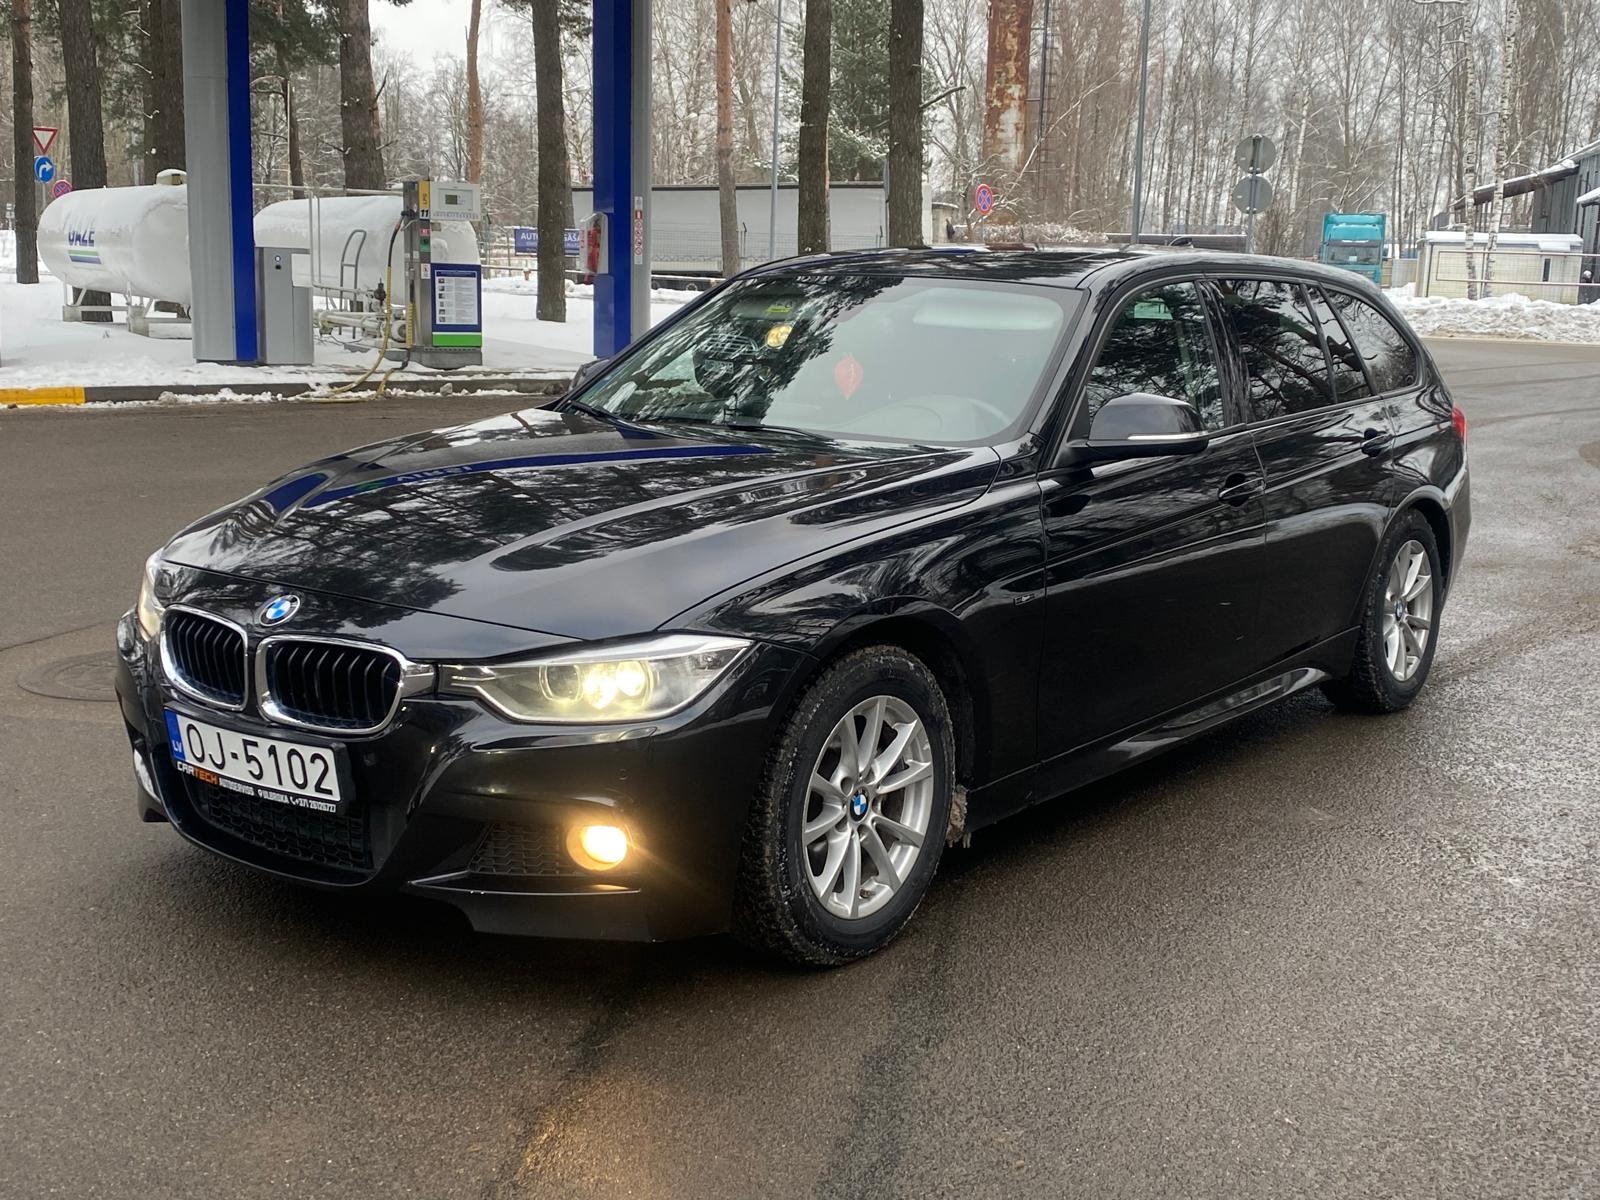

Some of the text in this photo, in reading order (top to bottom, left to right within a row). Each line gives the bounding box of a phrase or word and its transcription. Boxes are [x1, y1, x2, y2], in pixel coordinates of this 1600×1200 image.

[421, 209, 429, 217] 11
[172, 739, 183, 753] LV
[186, 723, 333, 796] OJ-5102
